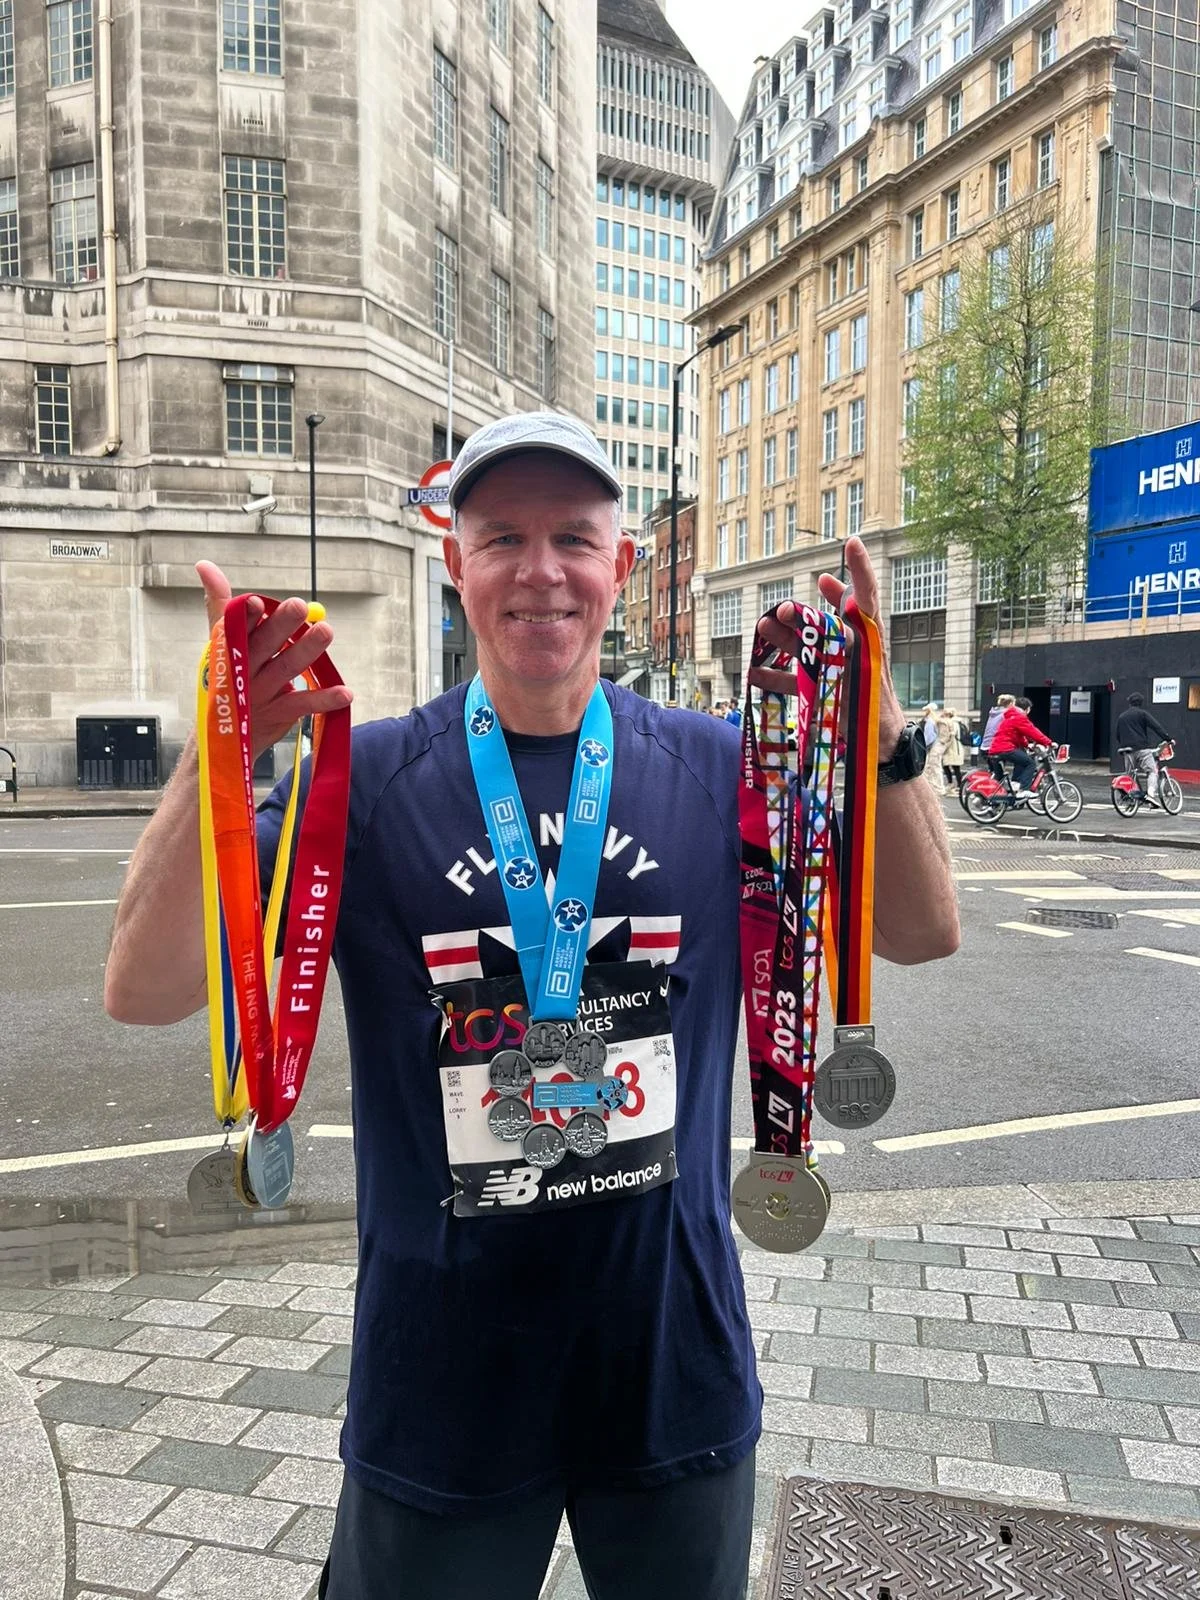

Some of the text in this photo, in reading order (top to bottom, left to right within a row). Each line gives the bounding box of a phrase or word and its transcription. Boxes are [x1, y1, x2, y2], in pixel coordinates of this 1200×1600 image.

[52, 545, 102, 557] BROADWAY
[232, 647, 246, 706] 2017
[215, 694, 234, 735] 2013
[445, 812, 660, 897] FL NVY
[290, 865, 330, 1013] Finisher
[780, 935, 794, 970] tcs
[242, 951, 256, 984] THE
[754, 948, 772, 984] tcs
[245, 988, 259, 1019] ING
[446, 1001, 527, 1053] tcs
[771, 990, 797, 1068] 2023
[547, 1162, 662, 1201] new balance
[760, 1168, 776, 1179] tcs
